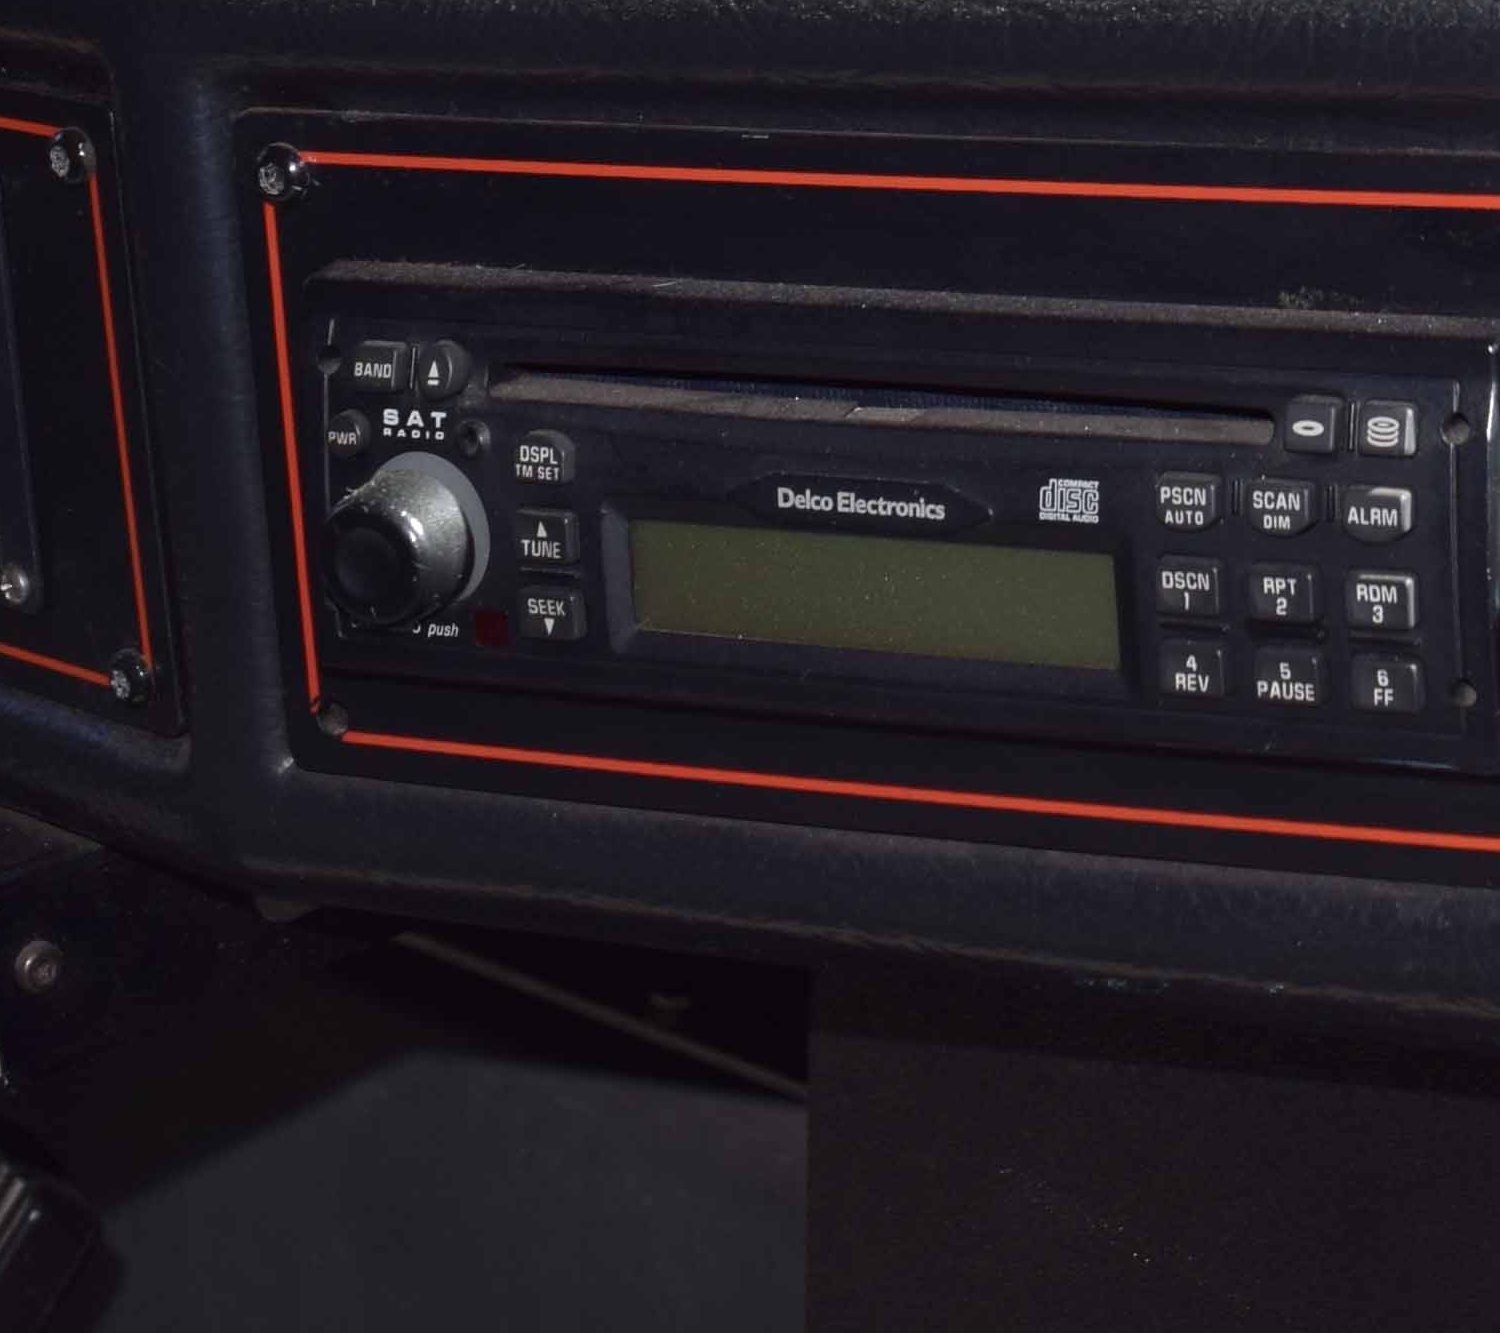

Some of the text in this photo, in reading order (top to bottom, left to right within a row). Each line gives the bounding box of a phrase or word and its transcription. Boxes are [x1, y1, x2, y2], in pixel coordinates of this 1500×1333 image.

[354, 362, 392, 379] BAND
[383, 409, 447, 428] SAT
[327, 431, 358, 446] PWR
[383, 428, 445, 440] RADIO
[519, 445, 559, 465] DSPL
[515, 464, 560, 480] TM SET
[777, 486, 946, 521] Delco Electronics
[1160, 487, 1207, 506] PSCN
[1252, 491, 1301, 511] SCAN
[1164, 510, 1204, 525] AUTO
[1263, 515, 1291, 530] DIM
[1348, 506, 1398, 527] ALRM
[521, 539, 562, 559] TUNE
[1161, 571, 1210, 591] DSCN
[1263, 577, 1296, 595] RPT
[1183, 592, 1190, 611] 1
[1356, 584, 1398, 603] RDM
[527, 597, 566, 616] SEEK
[1276, 597, 1288, 616] 2
[1372, 605, 1384, 624] 3
[428, 622, 459, 637] push
[1186, 655, 1198, 672] 4
[1279, 662, 1291, 680] 5
[1175, 673, 1209, 693] REV
[1377, 669, 1389, 687] 6
[1256, 681, 1316, 702] PAUSE
[1373, 689, 1394, 707] FF
